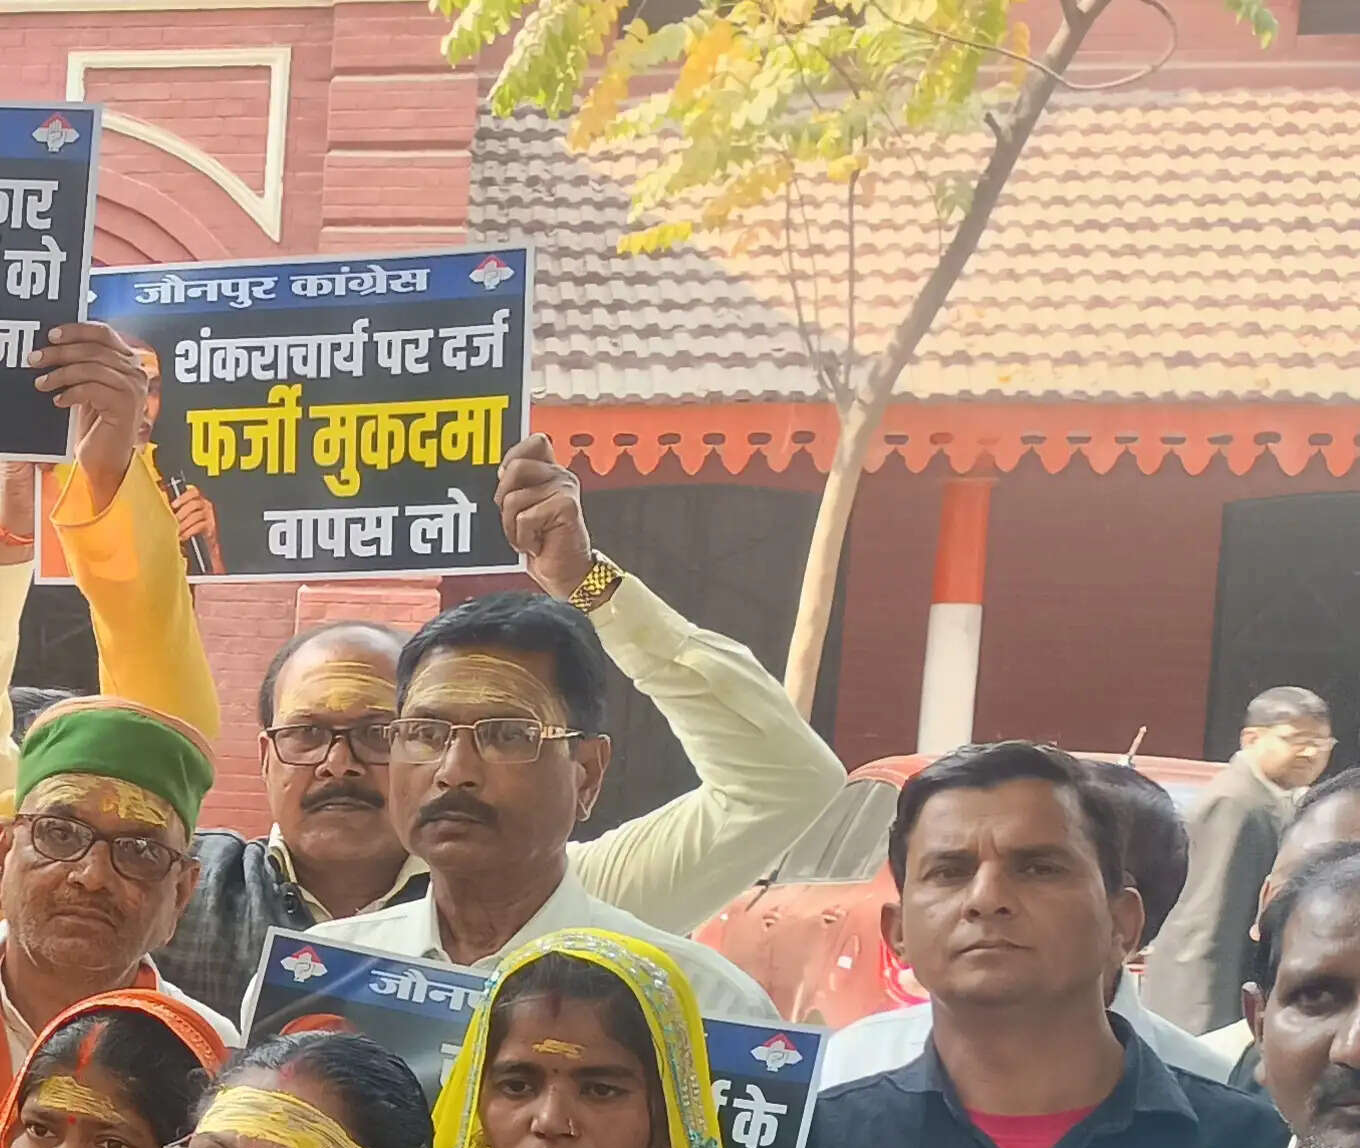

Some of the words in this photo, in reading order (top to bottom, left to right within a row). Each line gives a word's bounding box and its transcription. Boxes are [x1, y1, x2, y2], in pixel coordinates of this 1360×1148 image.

[3, 237, 67, 300] को
[134, 274, 278, 308] जौनपुर
[289, 265, 431, 297] कांग्रेस
[174, 318, 372, 384] शंकराचार्य
[372, 328, 434, 375] पर
[438, 309, 511, 372] दर्ज
[186, 384, 302, 477] फर्जी
[308, 395, 510, 498] मुकदमा
[263, 506, 399, 560] वापस
[403, 487, 478, 554] लो
